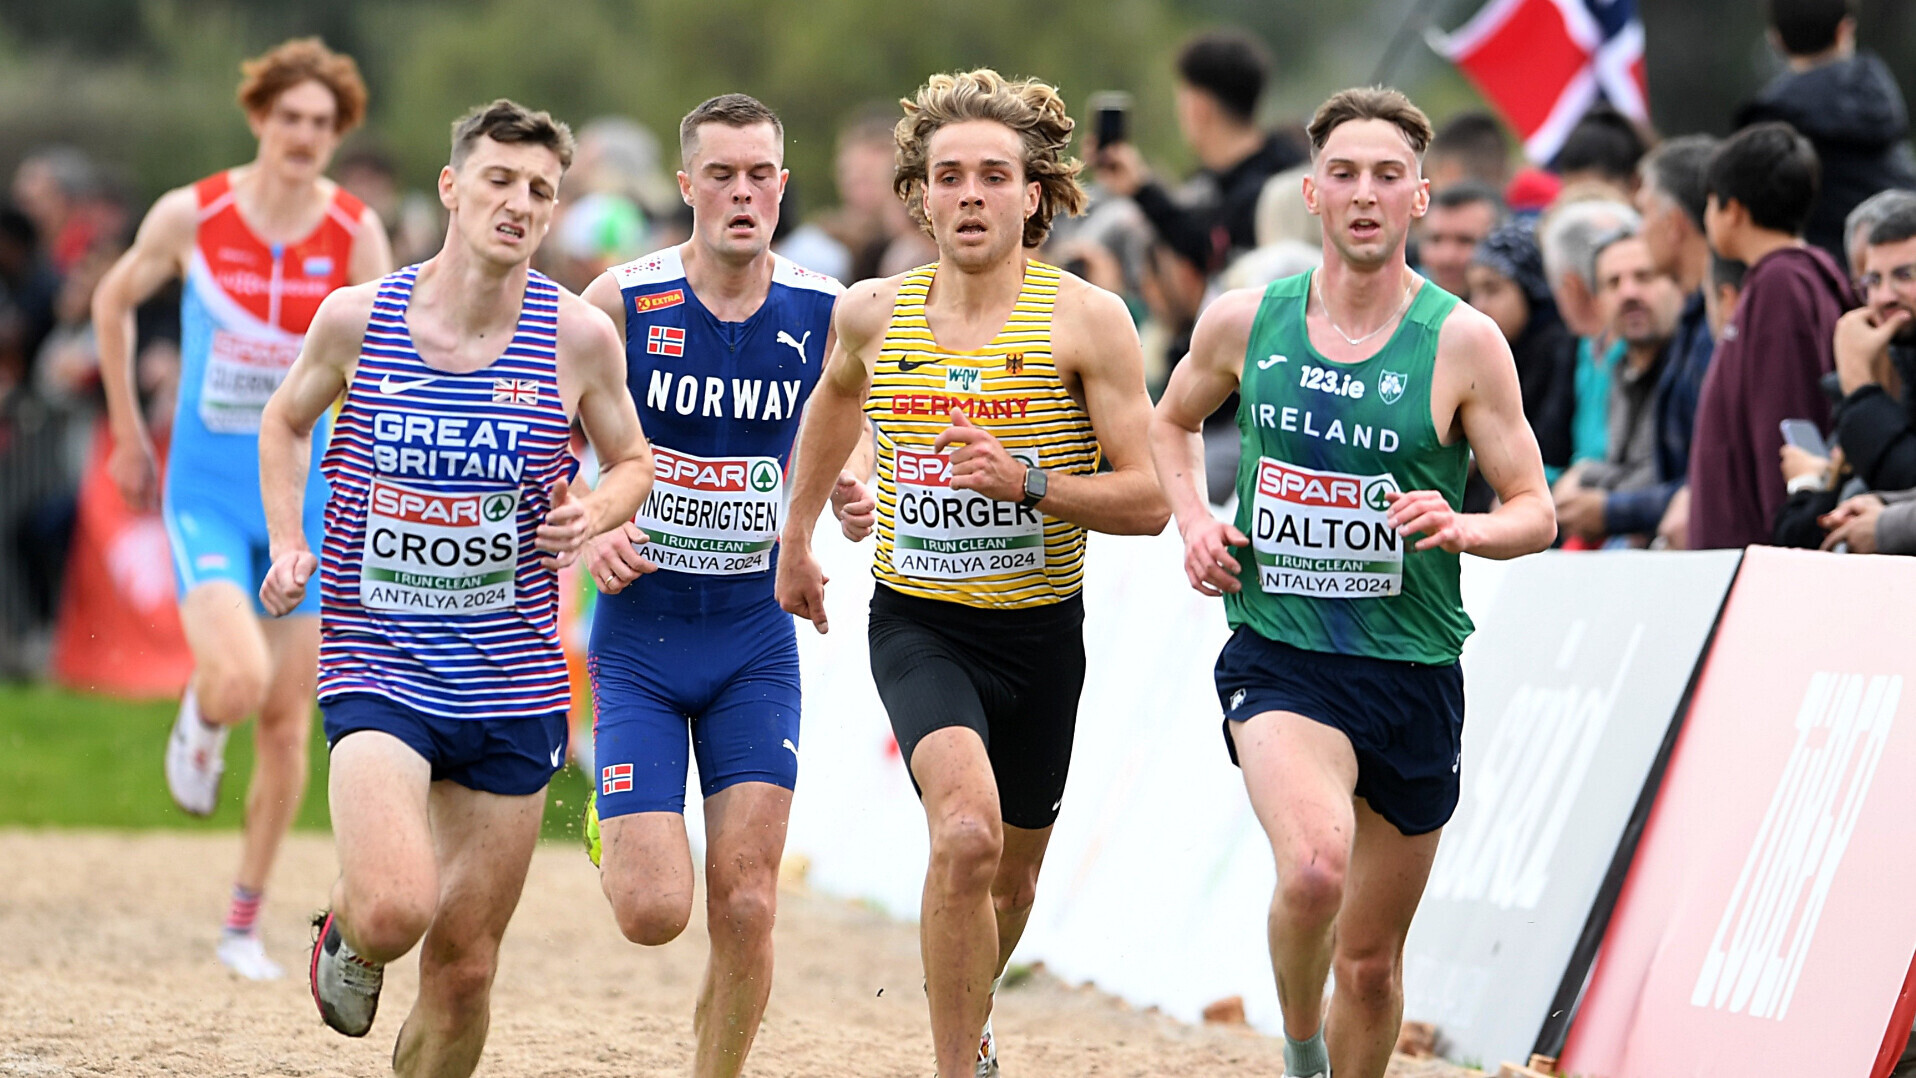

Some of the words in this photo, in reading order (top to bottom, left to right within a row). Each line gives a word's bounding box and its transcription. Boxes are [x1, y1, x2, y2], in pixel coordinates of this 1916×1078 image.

[652, 294, 681, 306] EXTRA
[647, 370, 801, 421] NORWAY
[1299, 365, 1365, 399] 123.ie
[892, 394, 1031, 420] GERMANY
[373, 412, 528, 451] GREAT
[1251, 403, 1399, 453] IRELAND
[373, 445, 524, 482] BRITAIN
[654, 453, 745, 488] SPAR
[1261, 466, 1358, 505] SPAR
[375, 489, 478, 523] SPAR
[642, 489, 778, 532] INGEBRIGTSEN
[900, 490, 1038, 529] GÖRGER
[662, 534, 667, 544] I
[668, 535, 698, 549] RUN
[923, 538, 927, 550] I
[929, 540, 956, 554] RUN
[1257, 507, 1397, 552] DALTON
[372, 528, 513, 567] CROSS
[639, 546, 719, 571] ANTALYA
[724, 554, 762, 571] 2024
[901, 555, 985, 574] ANTALYA
[989, 552, 1036, 570] 2024
[1275, 554, 1280, 566] I
[1282, 555, 1313, 570] RUN
[402, 573, 433, 588] RUN
[1344, 578, 1392, 592] 2024
[370, 587, 458, 609] ANTALYA
[463, 588, 506, 608] 2024
